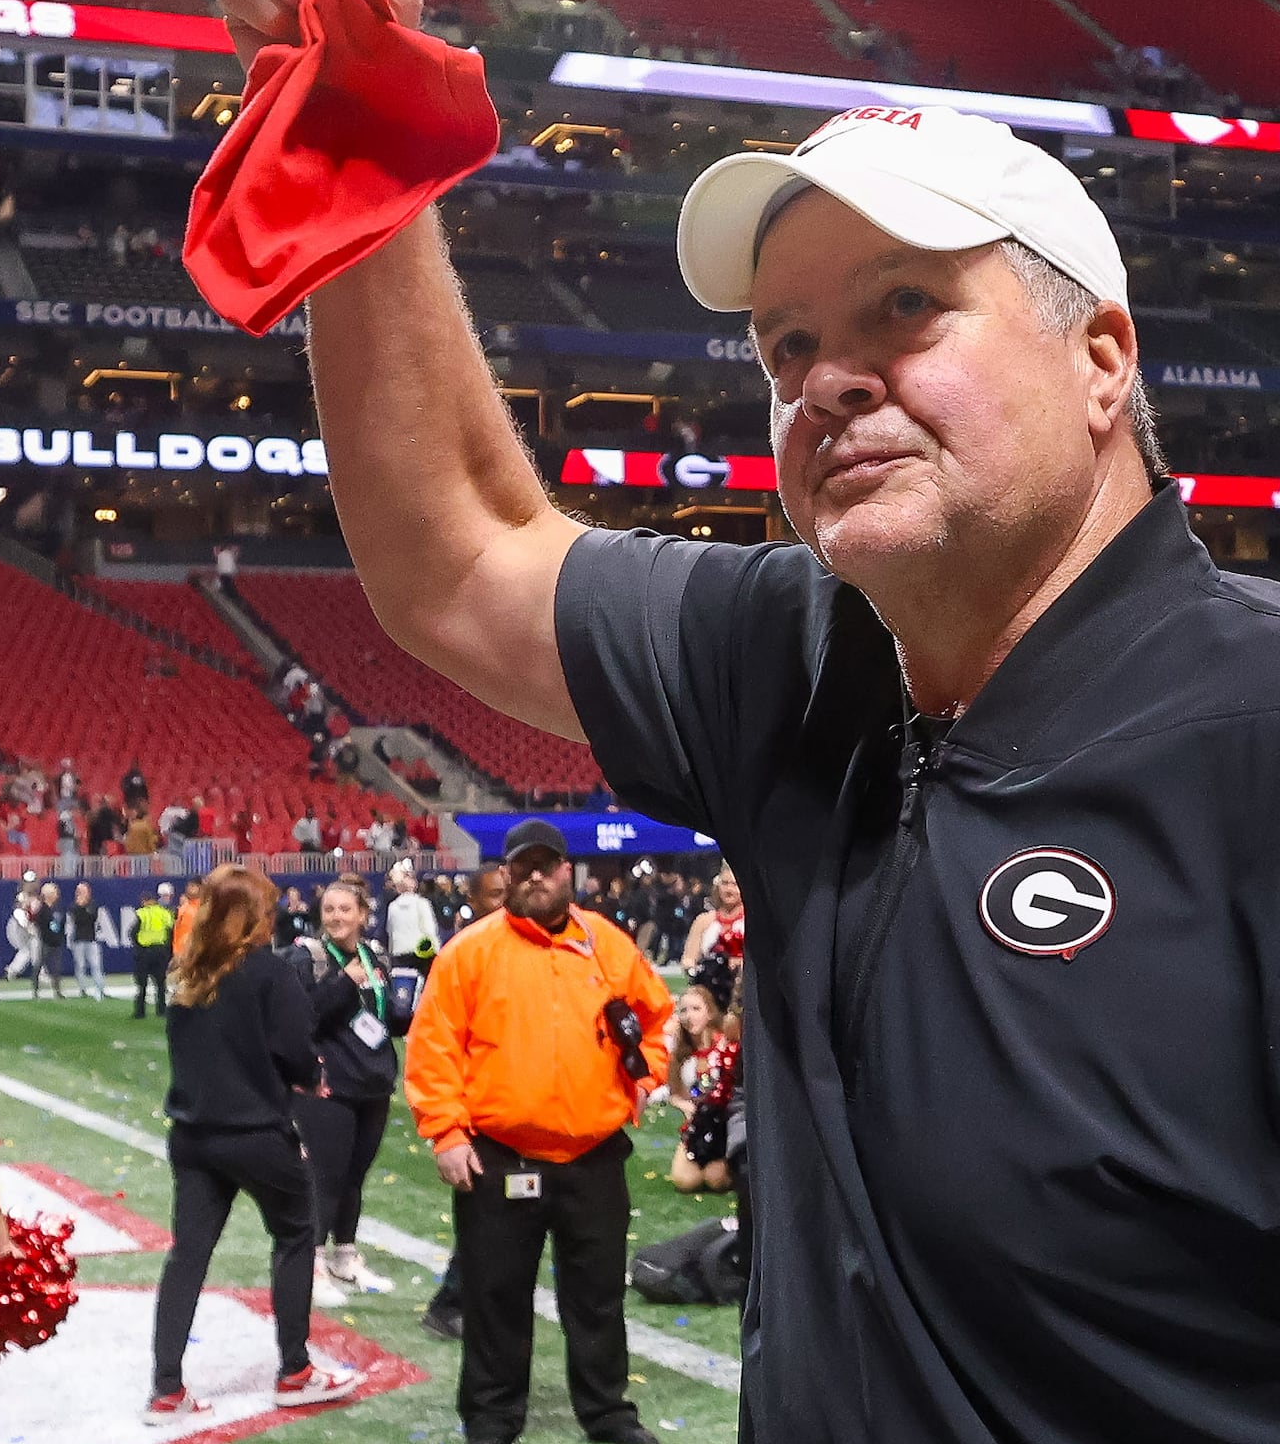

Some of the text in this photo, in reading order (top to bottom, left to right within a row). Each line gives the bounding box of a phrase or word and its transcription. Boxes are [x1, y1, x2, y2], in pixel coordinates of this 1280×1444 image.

[15, 300, 70, 323] SEC
[707, 338, 757, 360] GEO
[1163, 365, 1262, 389] ALABAMA
[981, 849, 1113, 952] G
